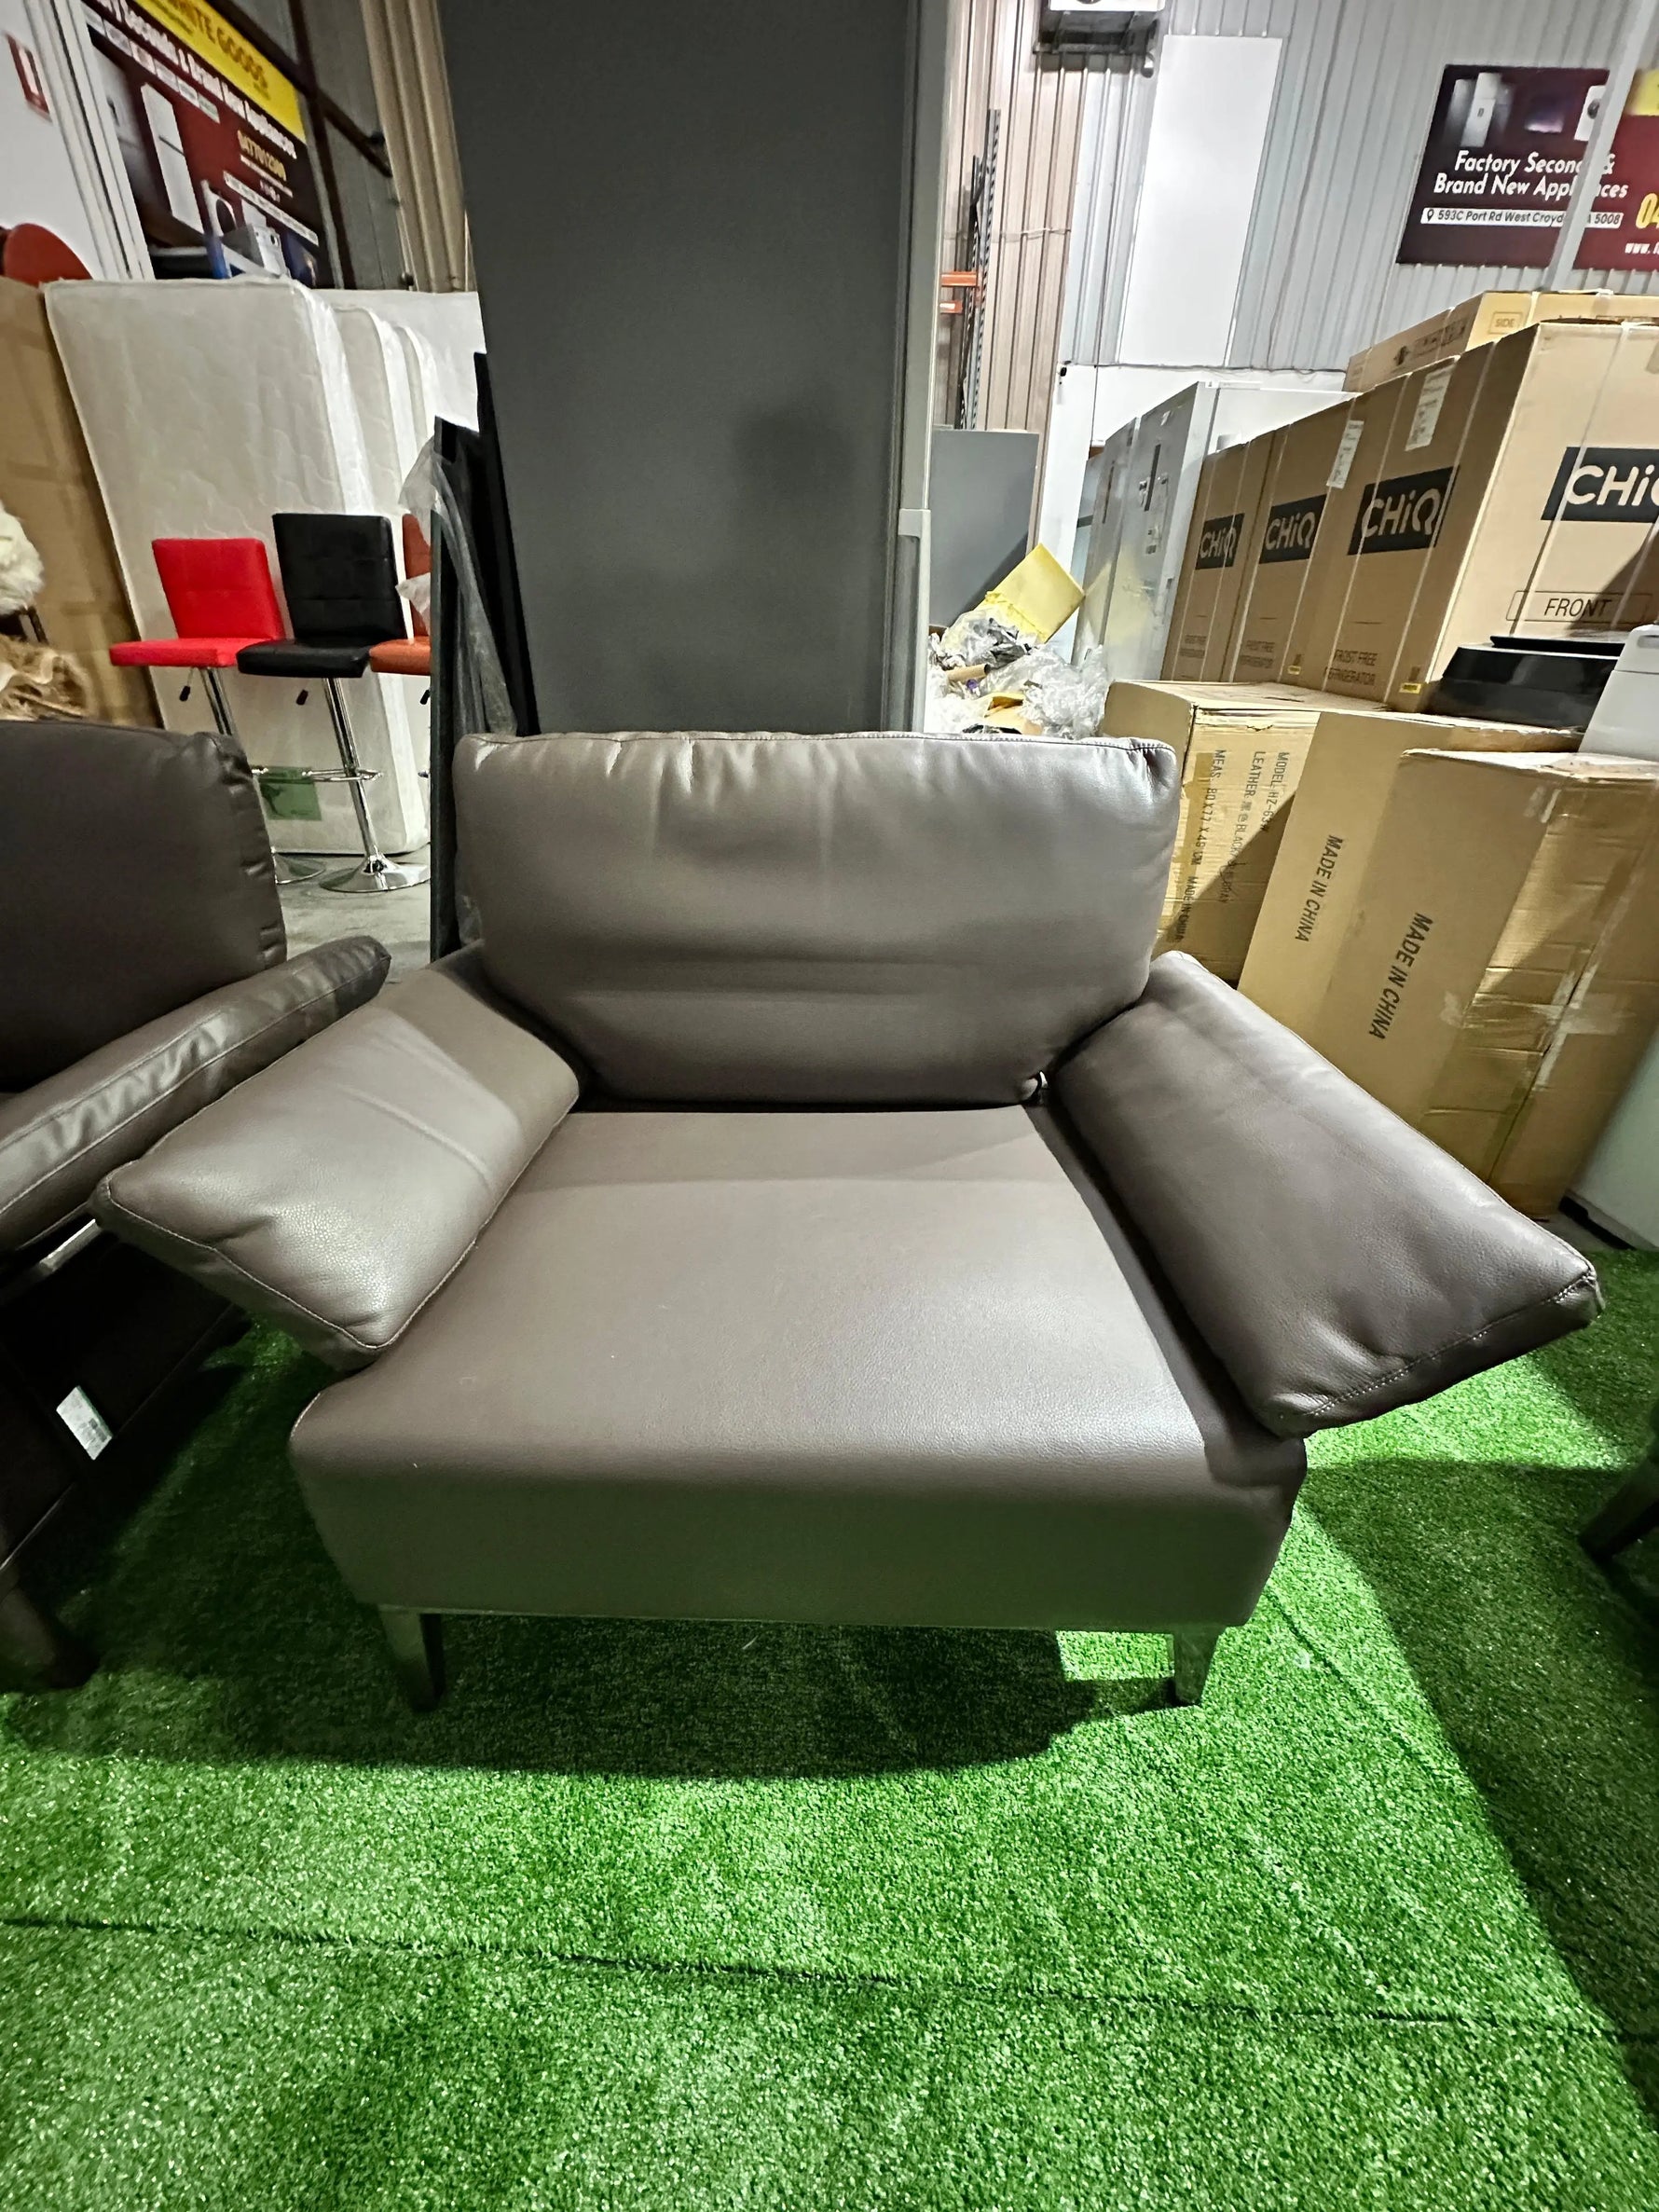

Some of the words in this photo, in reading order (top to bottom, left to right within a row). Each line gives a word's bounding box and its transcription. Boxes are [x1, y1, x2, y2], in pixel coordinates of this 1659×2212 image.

[1454, 149, 1520, 176] Factory
[1525, 151, 1583, 173] Secon
[1433, 172, 1489, 195] Brand
[1490, 174, 1530, 196] New
[1437, 210, 1463, 221] 593C
[1465, 211, 1488, 222] Port
[1488, 212, 1502, 222] Rd
[1504, 212, 1531, 223] West
[1532, 213, 1565, 227] Croyd
[1595, 213, 1622, 225] 5008
[1495, 317, 1515, 328] SIDE
[1566, 463, 1659, 507] CHi
[1543, 598, 1612, 617] FRONT
[1358, 651, 1378, 666] FREE
[1316, 834, 1343, 879] MADE
[1309, 880, 1327, 898] IN
[1295, 899, 1321, 942] CHINA
[1395, 912, 1433, 968] MADE
[1387, 965, 1408, 988] IN
[1368, 988, 1400, 1039] CHINA
